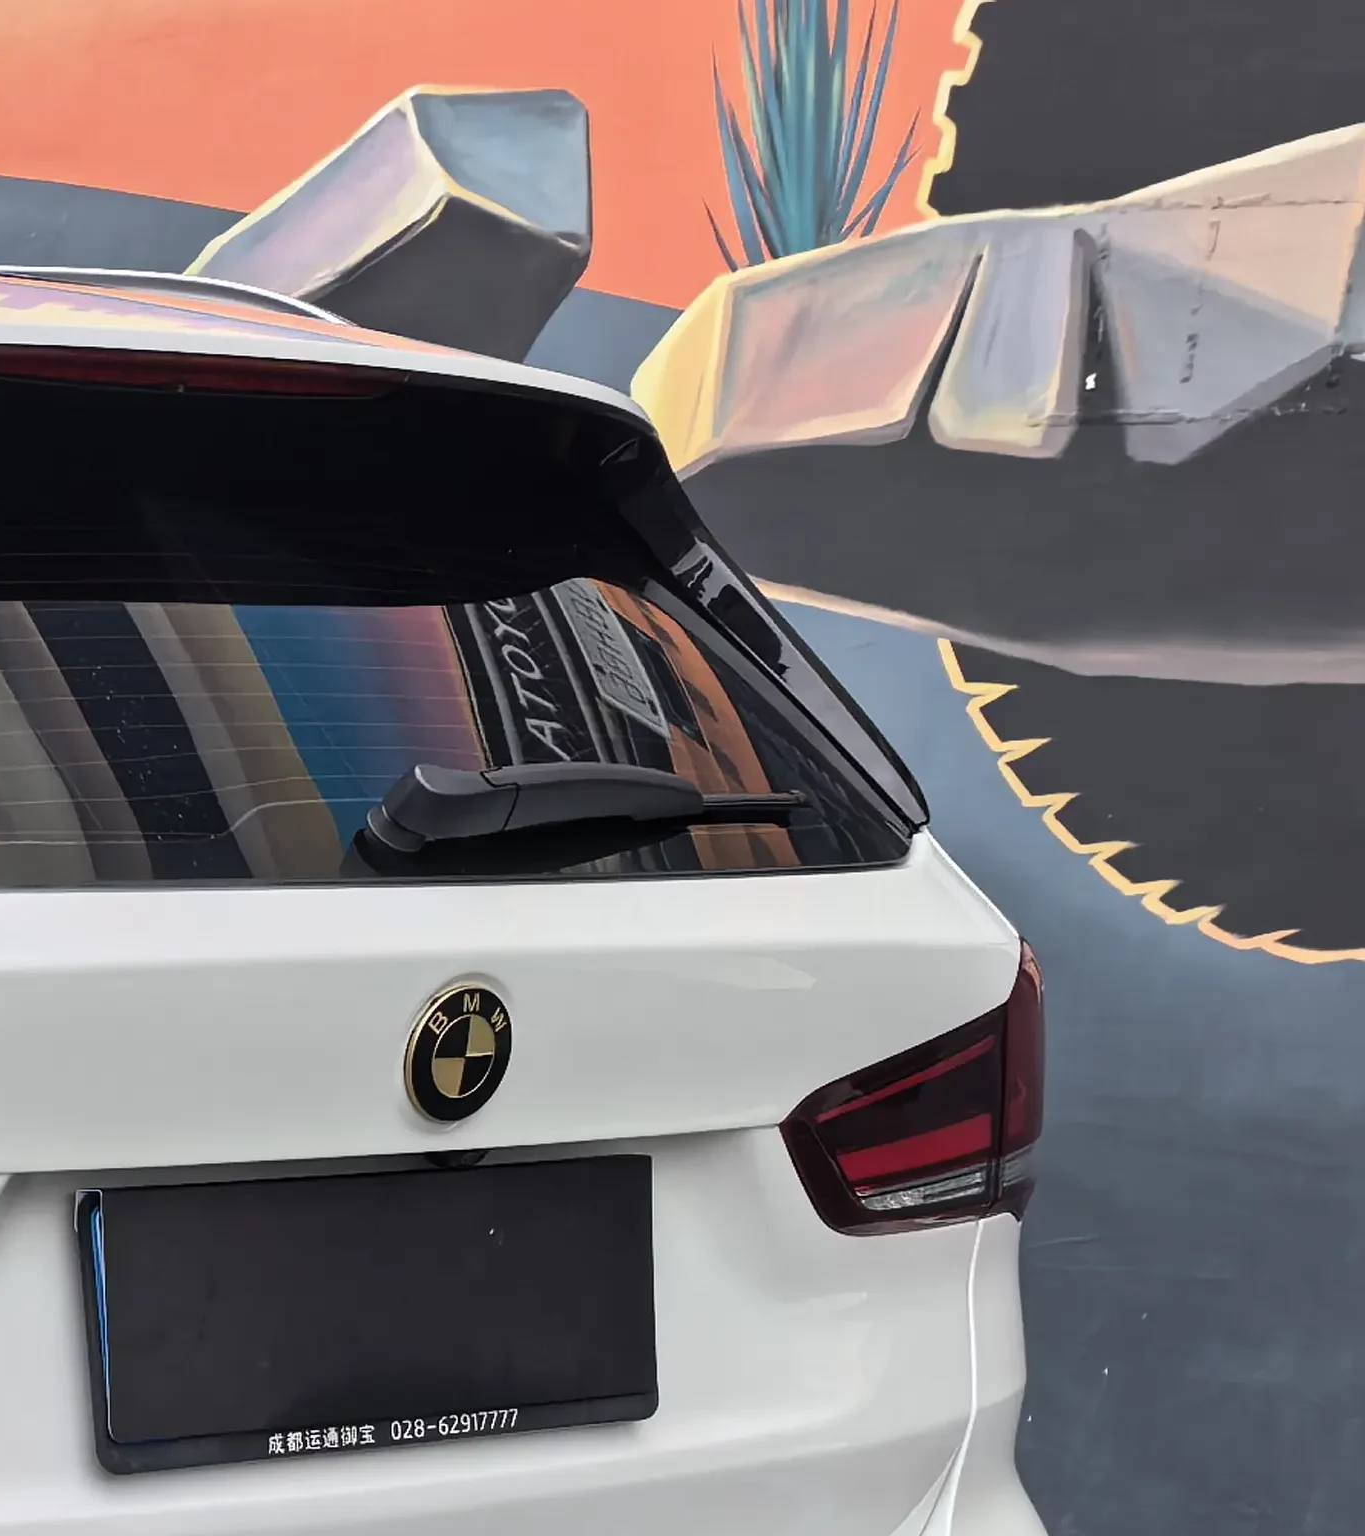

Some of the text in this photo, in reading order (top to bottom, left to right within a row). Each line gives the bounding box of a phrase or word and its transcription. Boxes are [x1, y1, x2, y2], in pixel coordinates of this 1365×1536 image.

[427, 992, 508, 1034] BMW
[268, 1408, 518, 1455] 成都运通御宝 028-62917777
